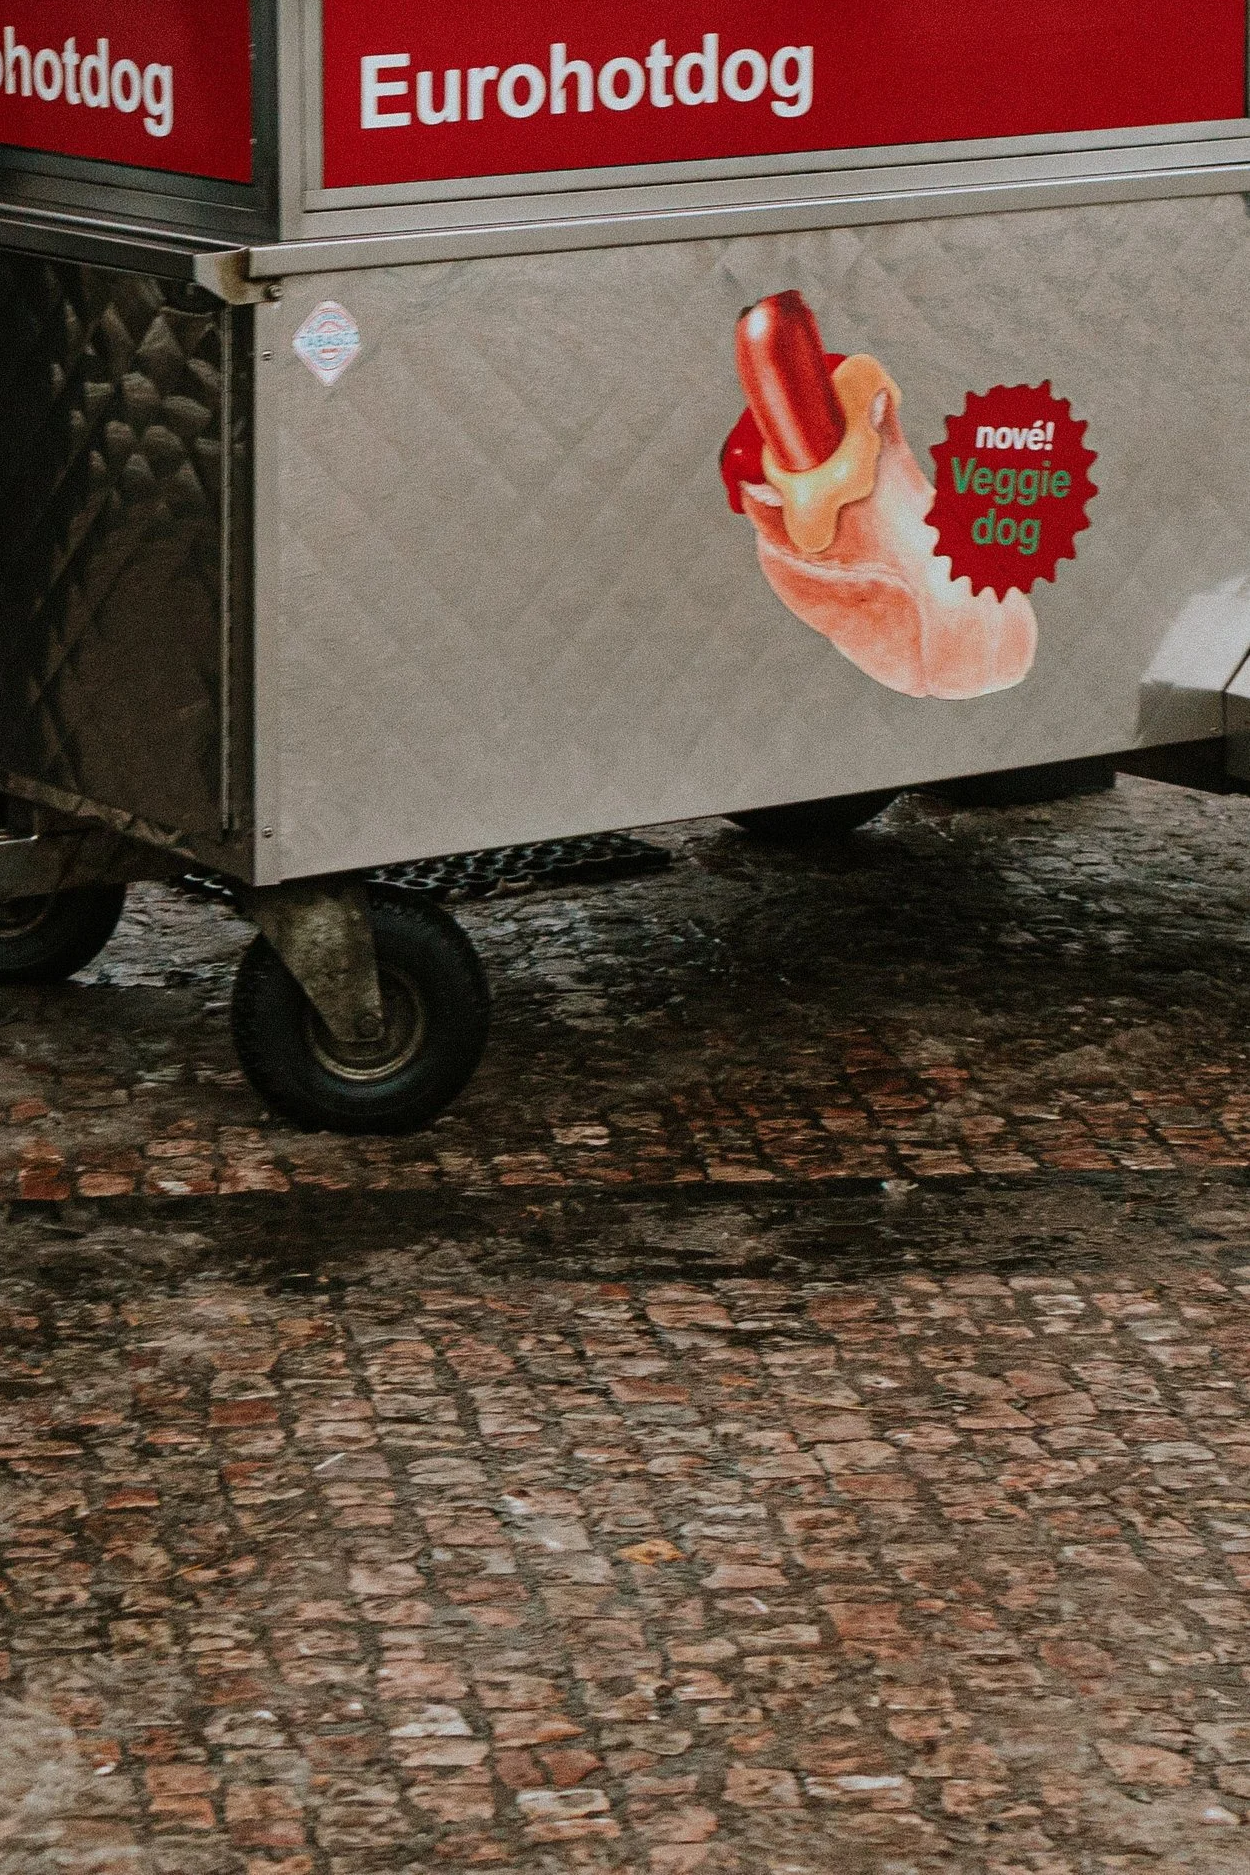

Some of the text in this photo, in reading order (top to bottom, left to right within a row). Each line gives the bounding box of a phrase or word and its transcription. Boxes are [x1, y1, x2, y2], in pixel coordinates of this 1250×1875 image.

[360, 32, 814, 129] Eurohotdog
[975, 420, 1055, 450] nové!
[951, 457, 1071, 506] Veggie
[972, 509, 1041, 555] dog
